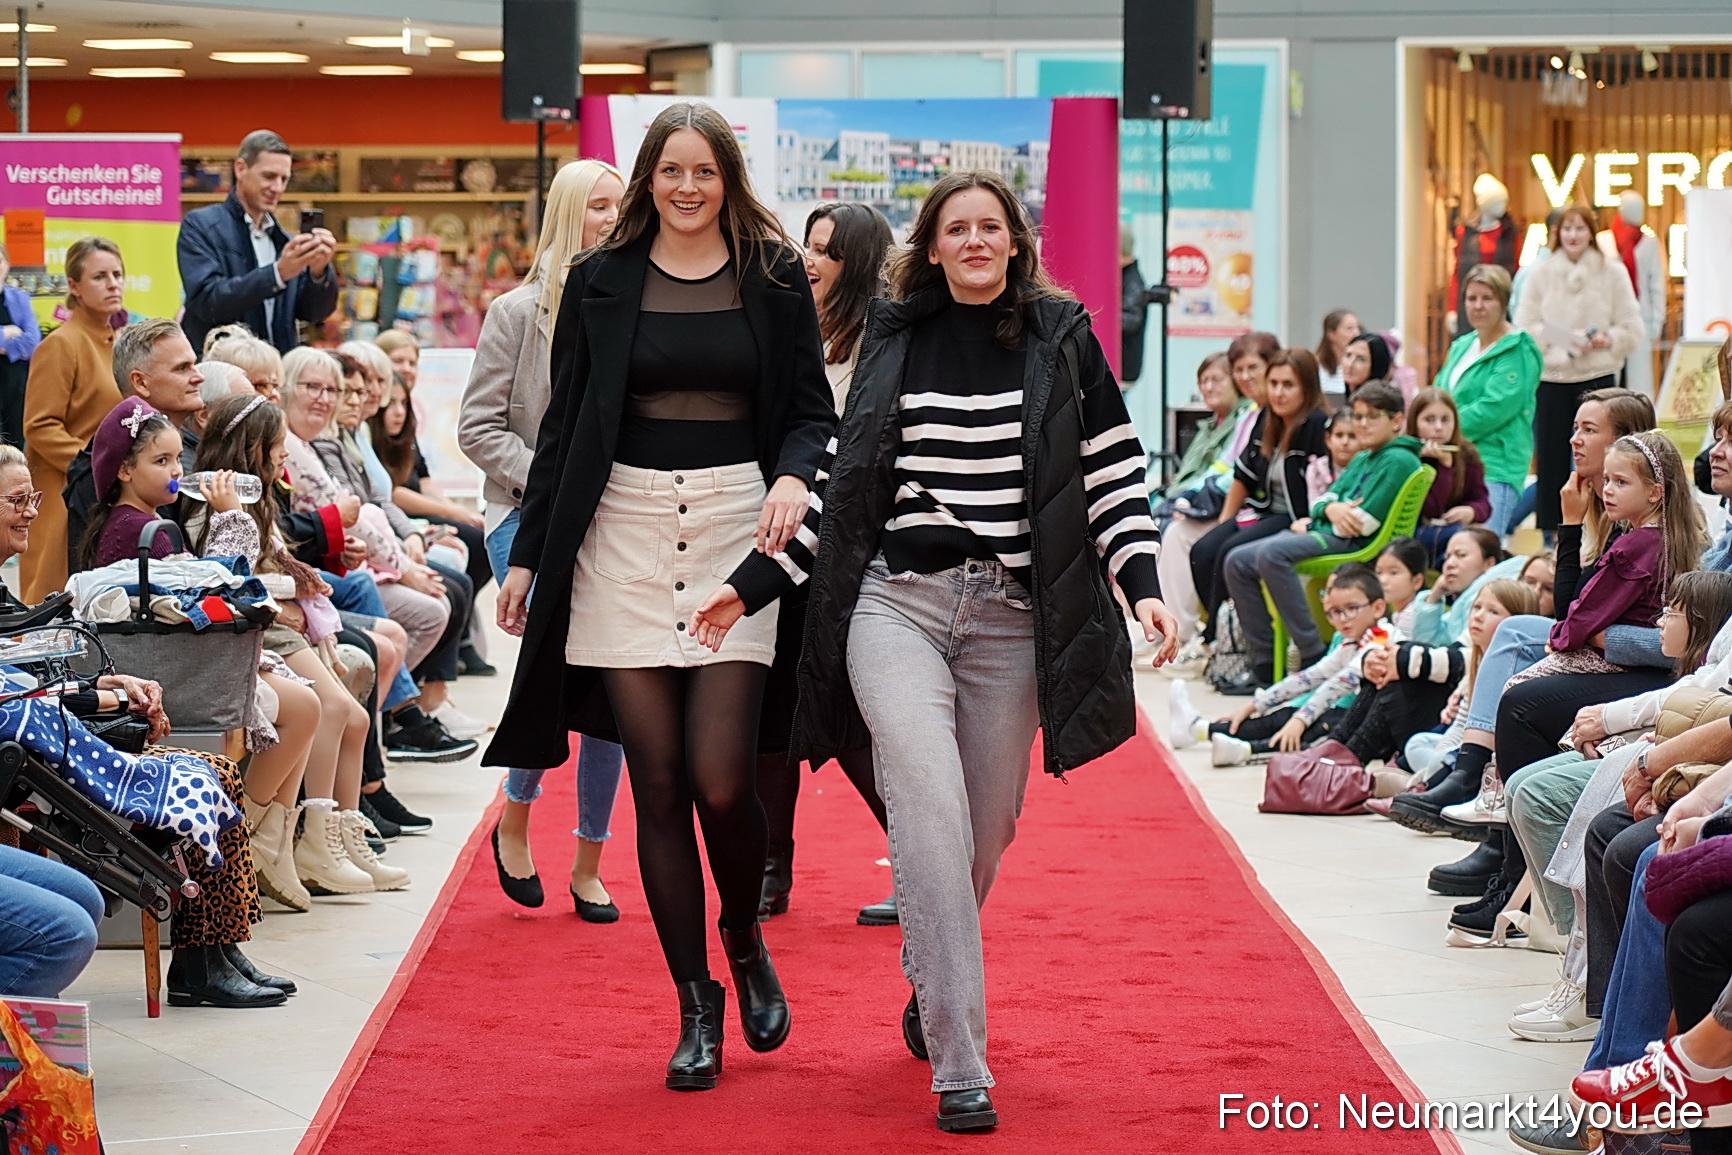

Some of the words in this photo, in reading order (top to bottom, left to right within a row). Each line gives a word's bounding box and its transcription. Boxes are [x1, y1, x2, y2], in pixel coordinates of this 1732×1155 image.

[5, 163, 129, 184] Verschenken
[131, 163, 162, 184] Sie
[46, 185, 163, 206] Gutscheine!
